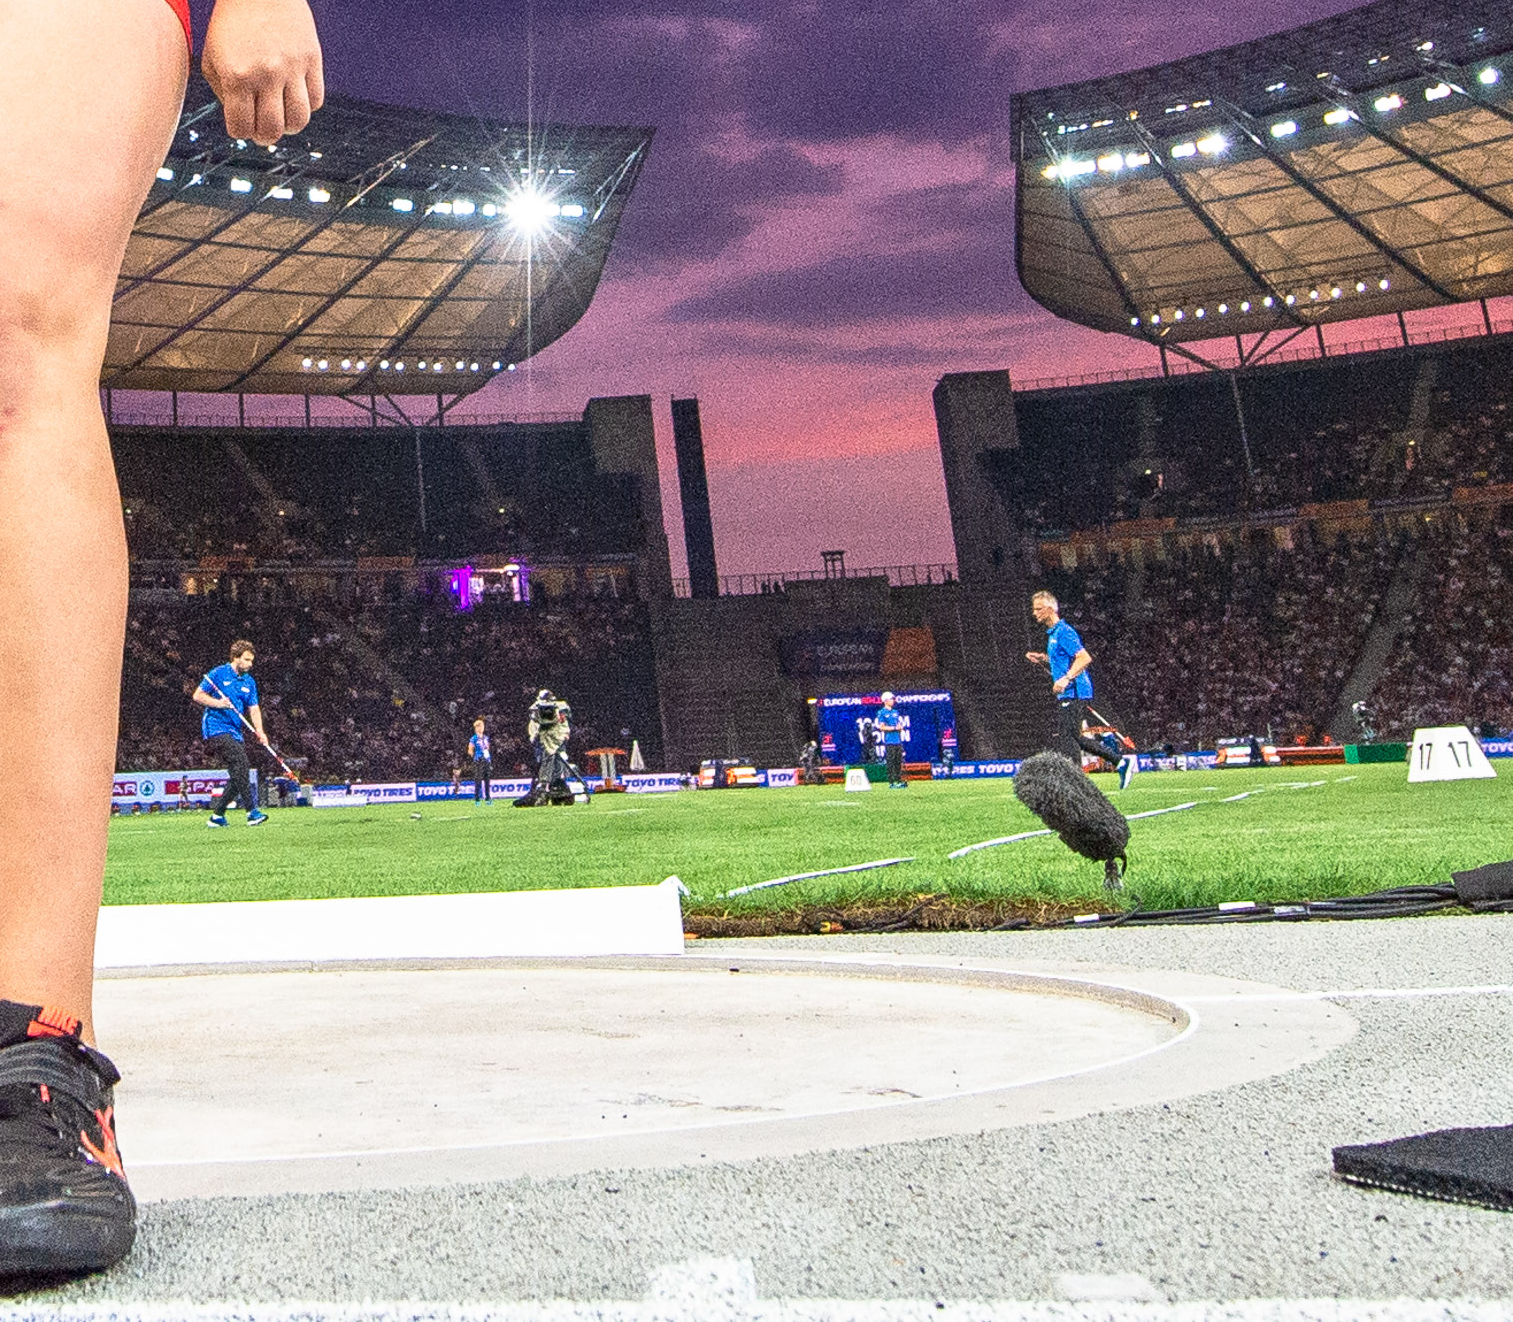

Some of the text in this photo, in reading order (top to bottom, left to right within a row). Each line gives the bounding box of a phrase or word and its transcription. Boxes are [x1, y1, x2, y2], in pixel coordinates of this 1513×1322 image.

[1418, 743, 1433, 770] 17
[1448, 740, 1472, 768] 17
[978, 762, 1014, 774] TOYO
[625, 779, 655, 790] TOYO
[382, 787, 414, 796] TIRES
[417, 786, 449, 796] TOYO
